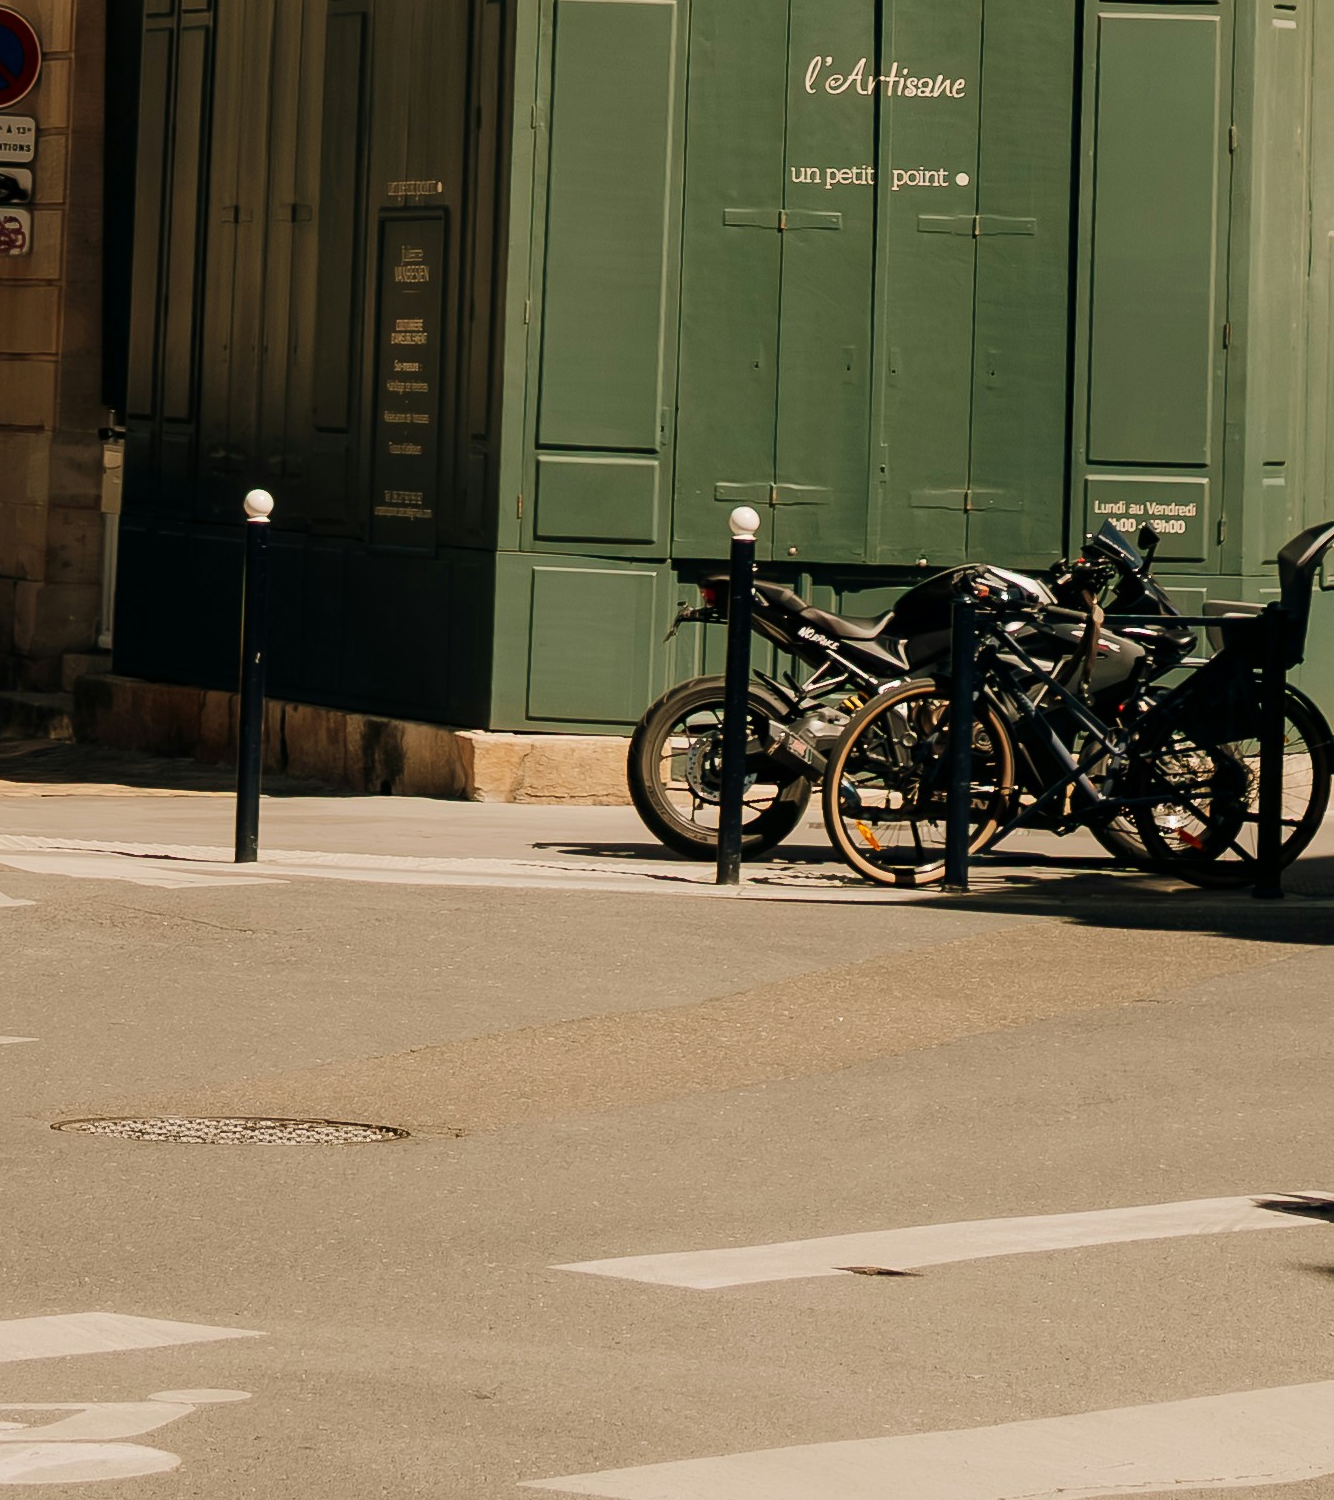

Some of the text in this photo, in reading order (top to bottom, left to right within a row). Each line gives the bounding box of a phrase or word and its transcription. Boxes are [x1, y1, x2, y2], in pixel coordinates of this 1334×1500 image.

[791, 165, 949, 191] un petit point
[1094, 500, 1197, 517] Lundi au Vendredi
